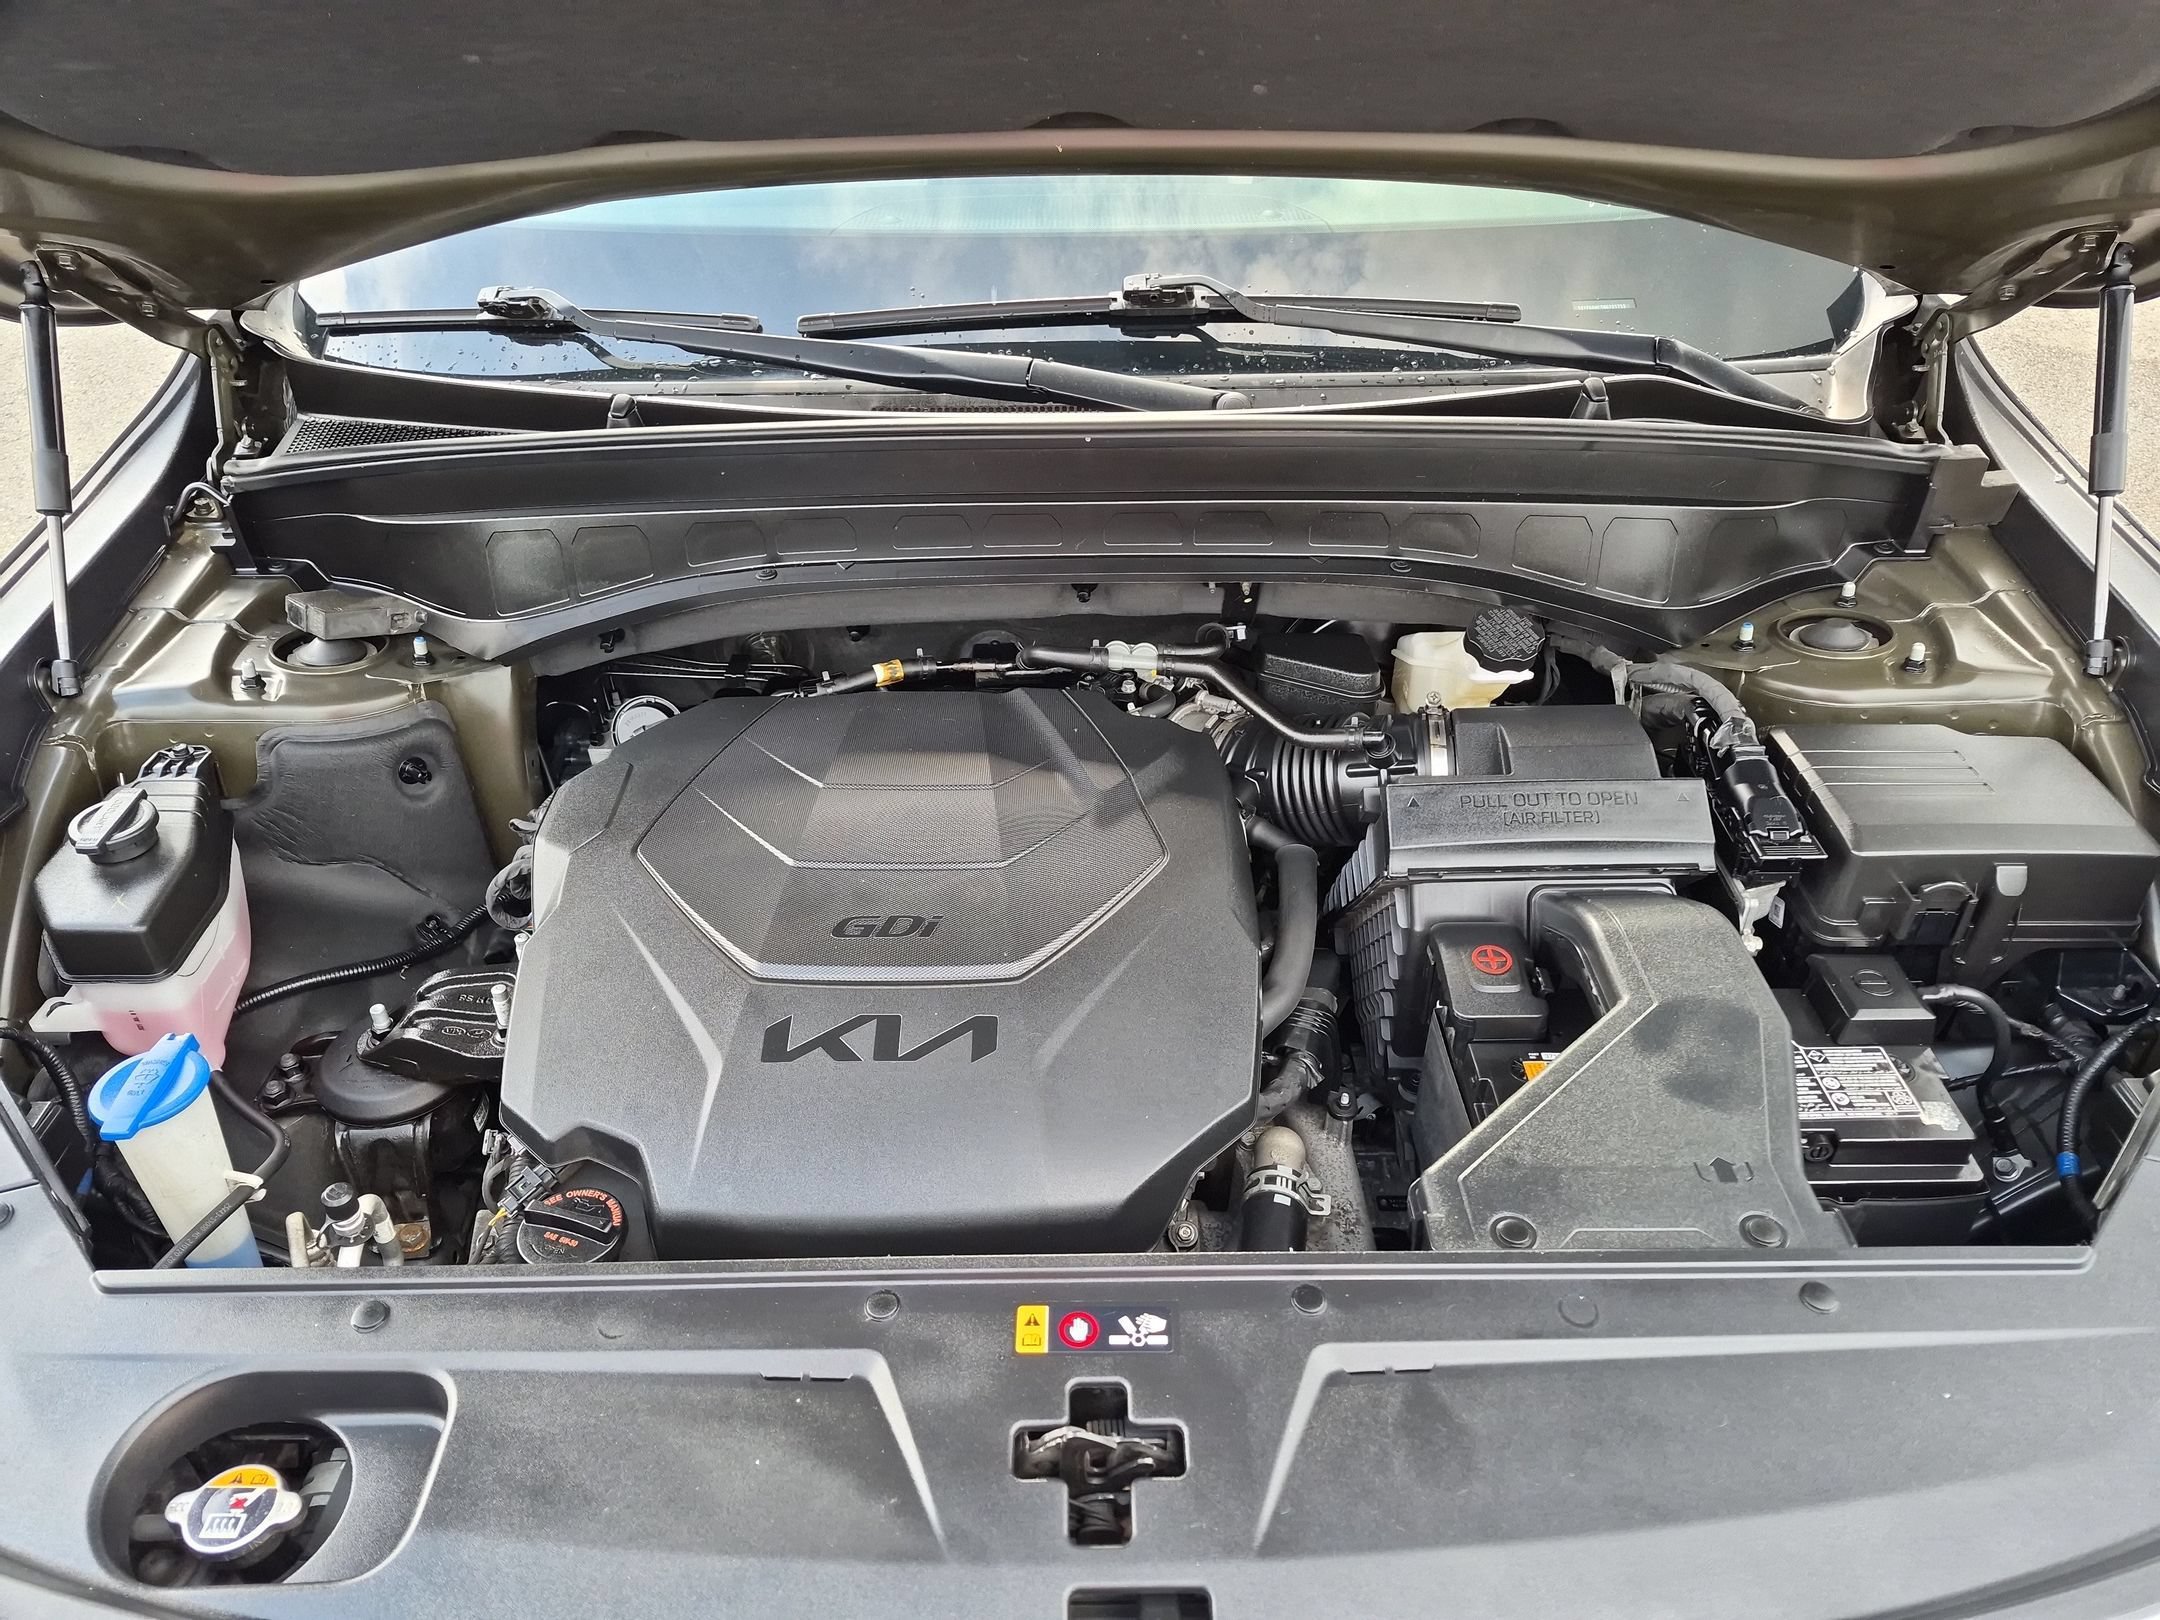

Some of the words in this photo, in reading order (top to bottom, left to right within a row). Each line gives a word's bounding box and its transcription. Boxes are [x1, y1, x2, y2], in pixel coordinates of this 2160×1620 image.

[1460, 794, 1507, 809] PULL
[1513, 792, 1551, 807] OUT
[1556, 791, 1582, 806] TO
[1587, 791, 1639, 806] OPEN
[831, 915, 945, 939] GDi
[761, 1013, 999, 1063] KIA
[543, 1193, 564, 1207] SEE
[566, 1189, 608, 1201] OWNER'S
